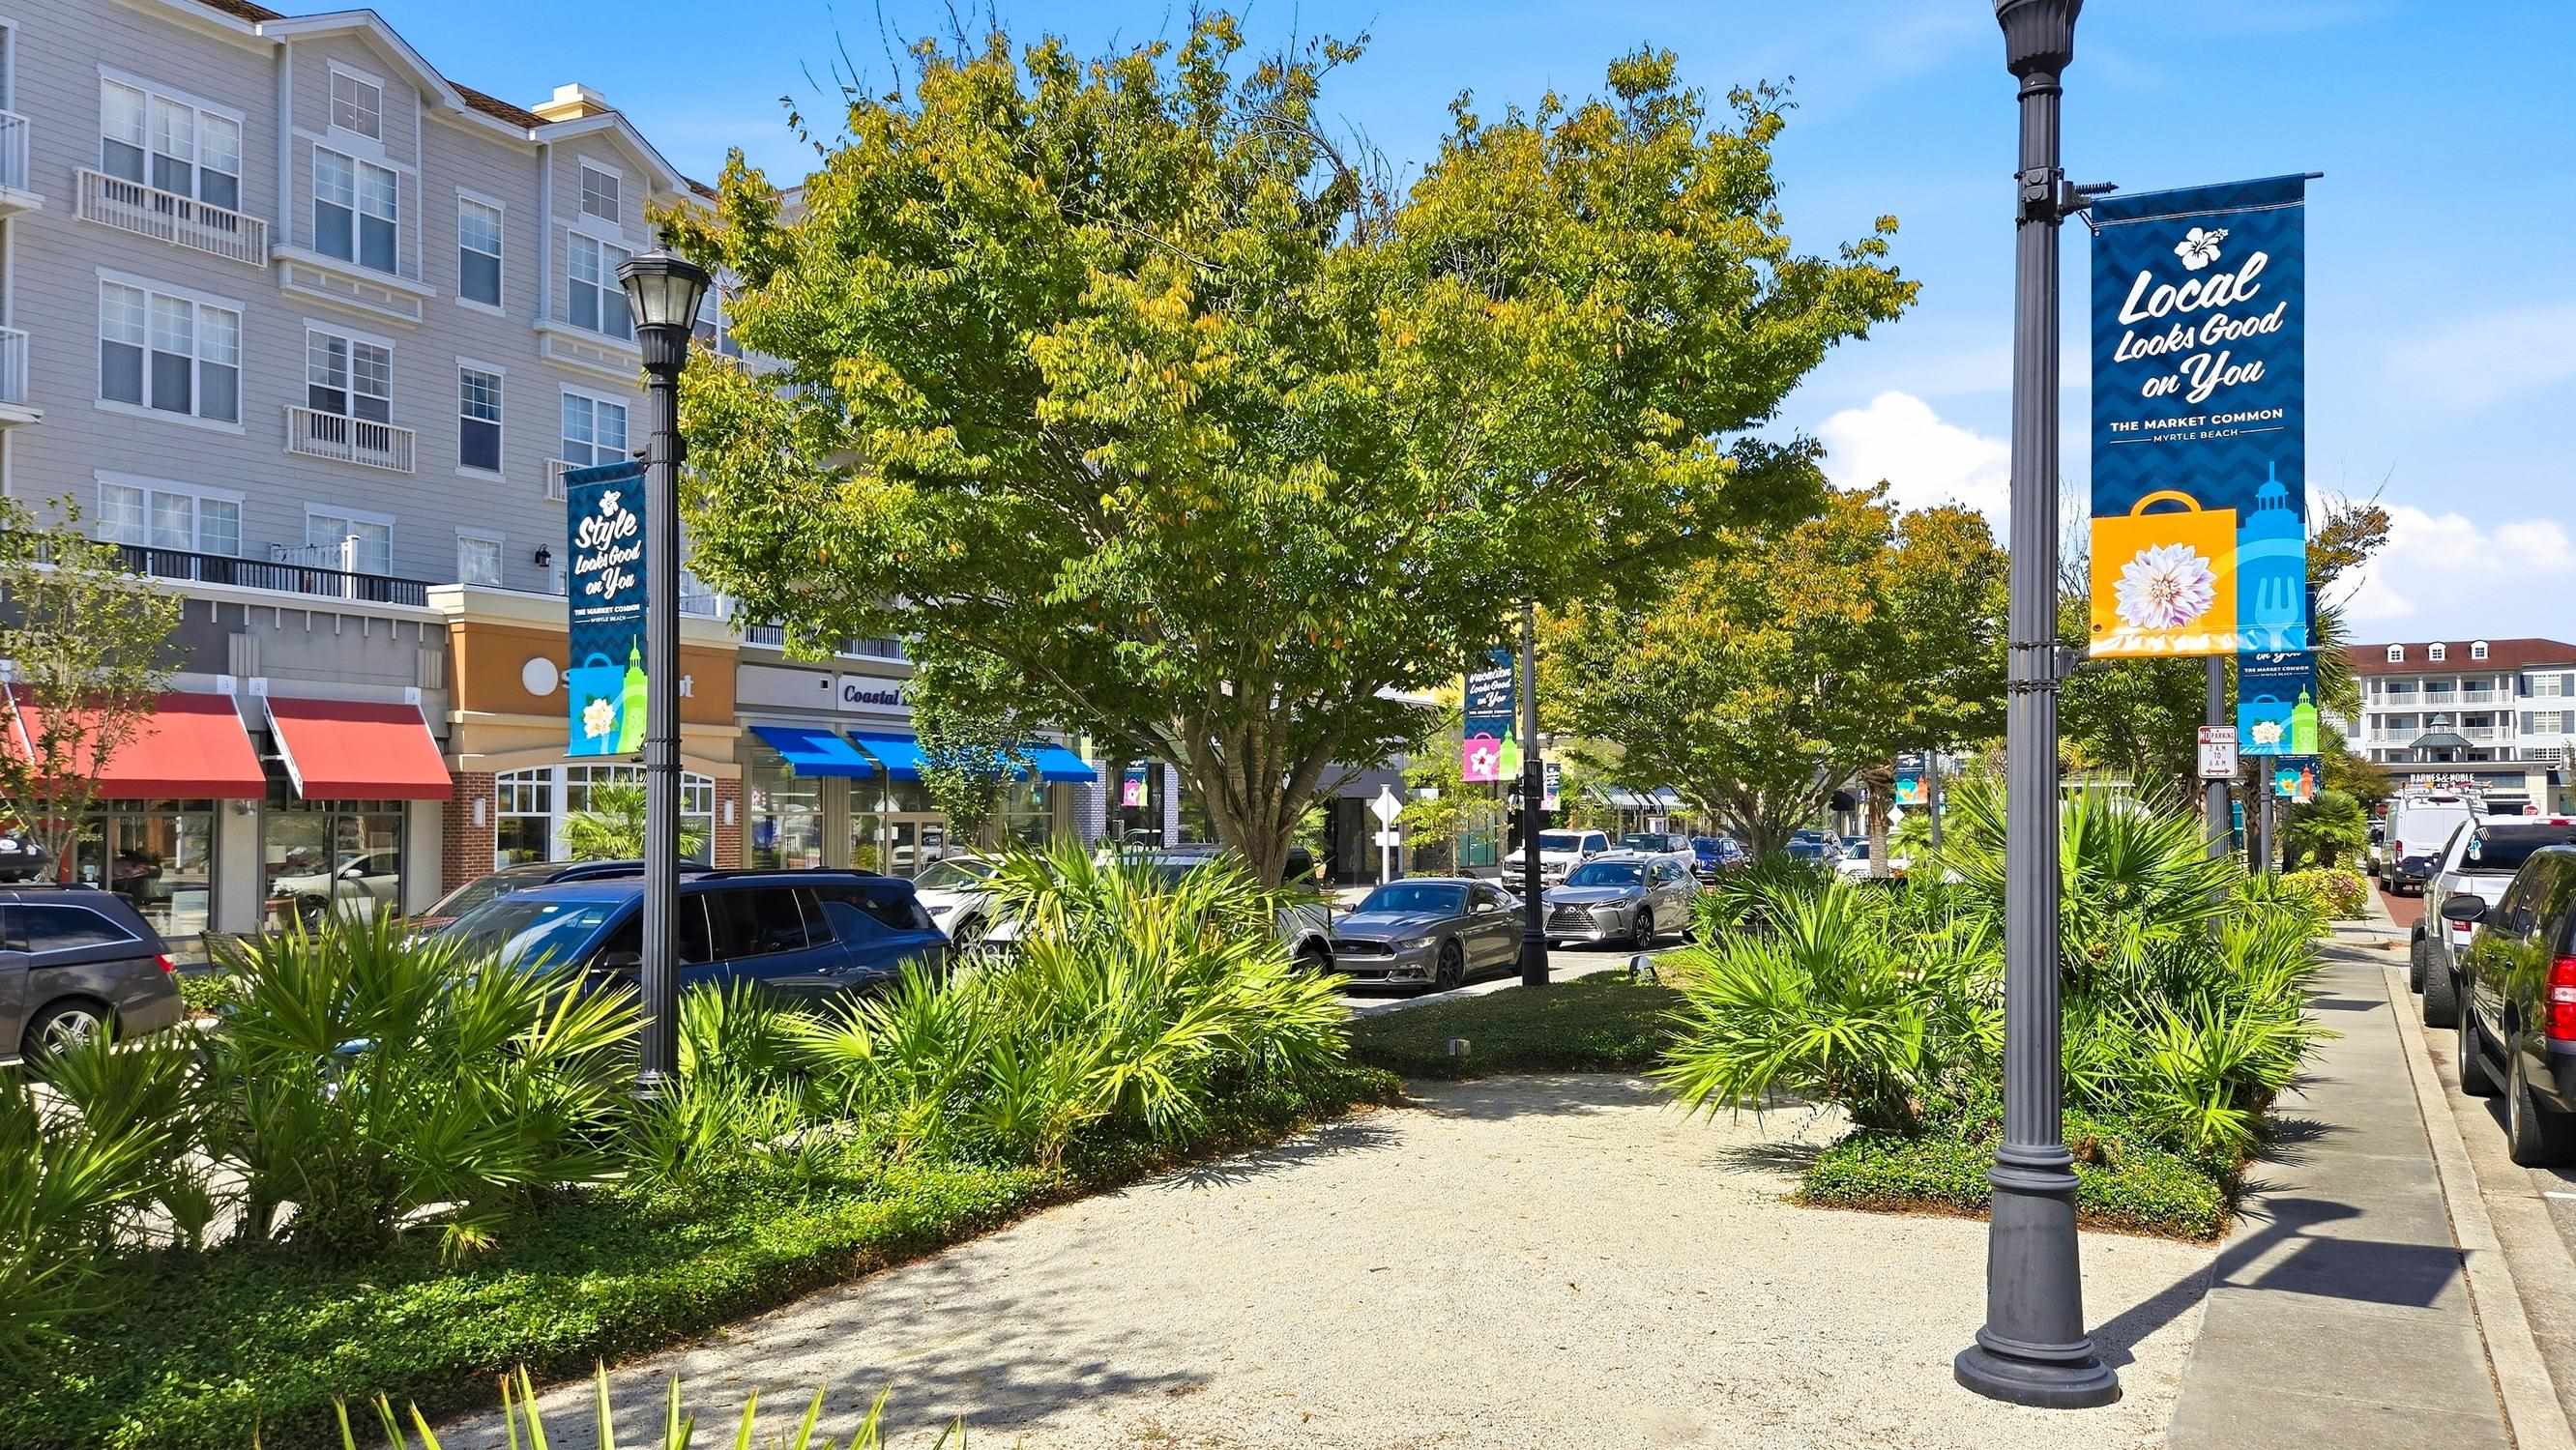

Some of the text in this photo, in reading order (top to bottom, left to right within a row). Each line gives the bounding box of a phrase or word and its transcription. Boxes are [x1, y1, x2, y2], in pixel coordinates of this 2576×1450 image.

[2119, 251, 2269, 325] Local
[2114, 302, 2287, 362] Looks Good
[2142, 350, 2265, 404] on You
[2110, 408, 2283, 432] THE MARKET COMMON
[2153, 428, 2239, 443] MYRTLE BEACH
[575, 508, 637, 551] Style
[574, 540, 642, 575] Looks Good
[586, 566, 634, 599] on You
[844, 685, 899, 706] Coastal
[2201, 731, 2210, 741] NO
